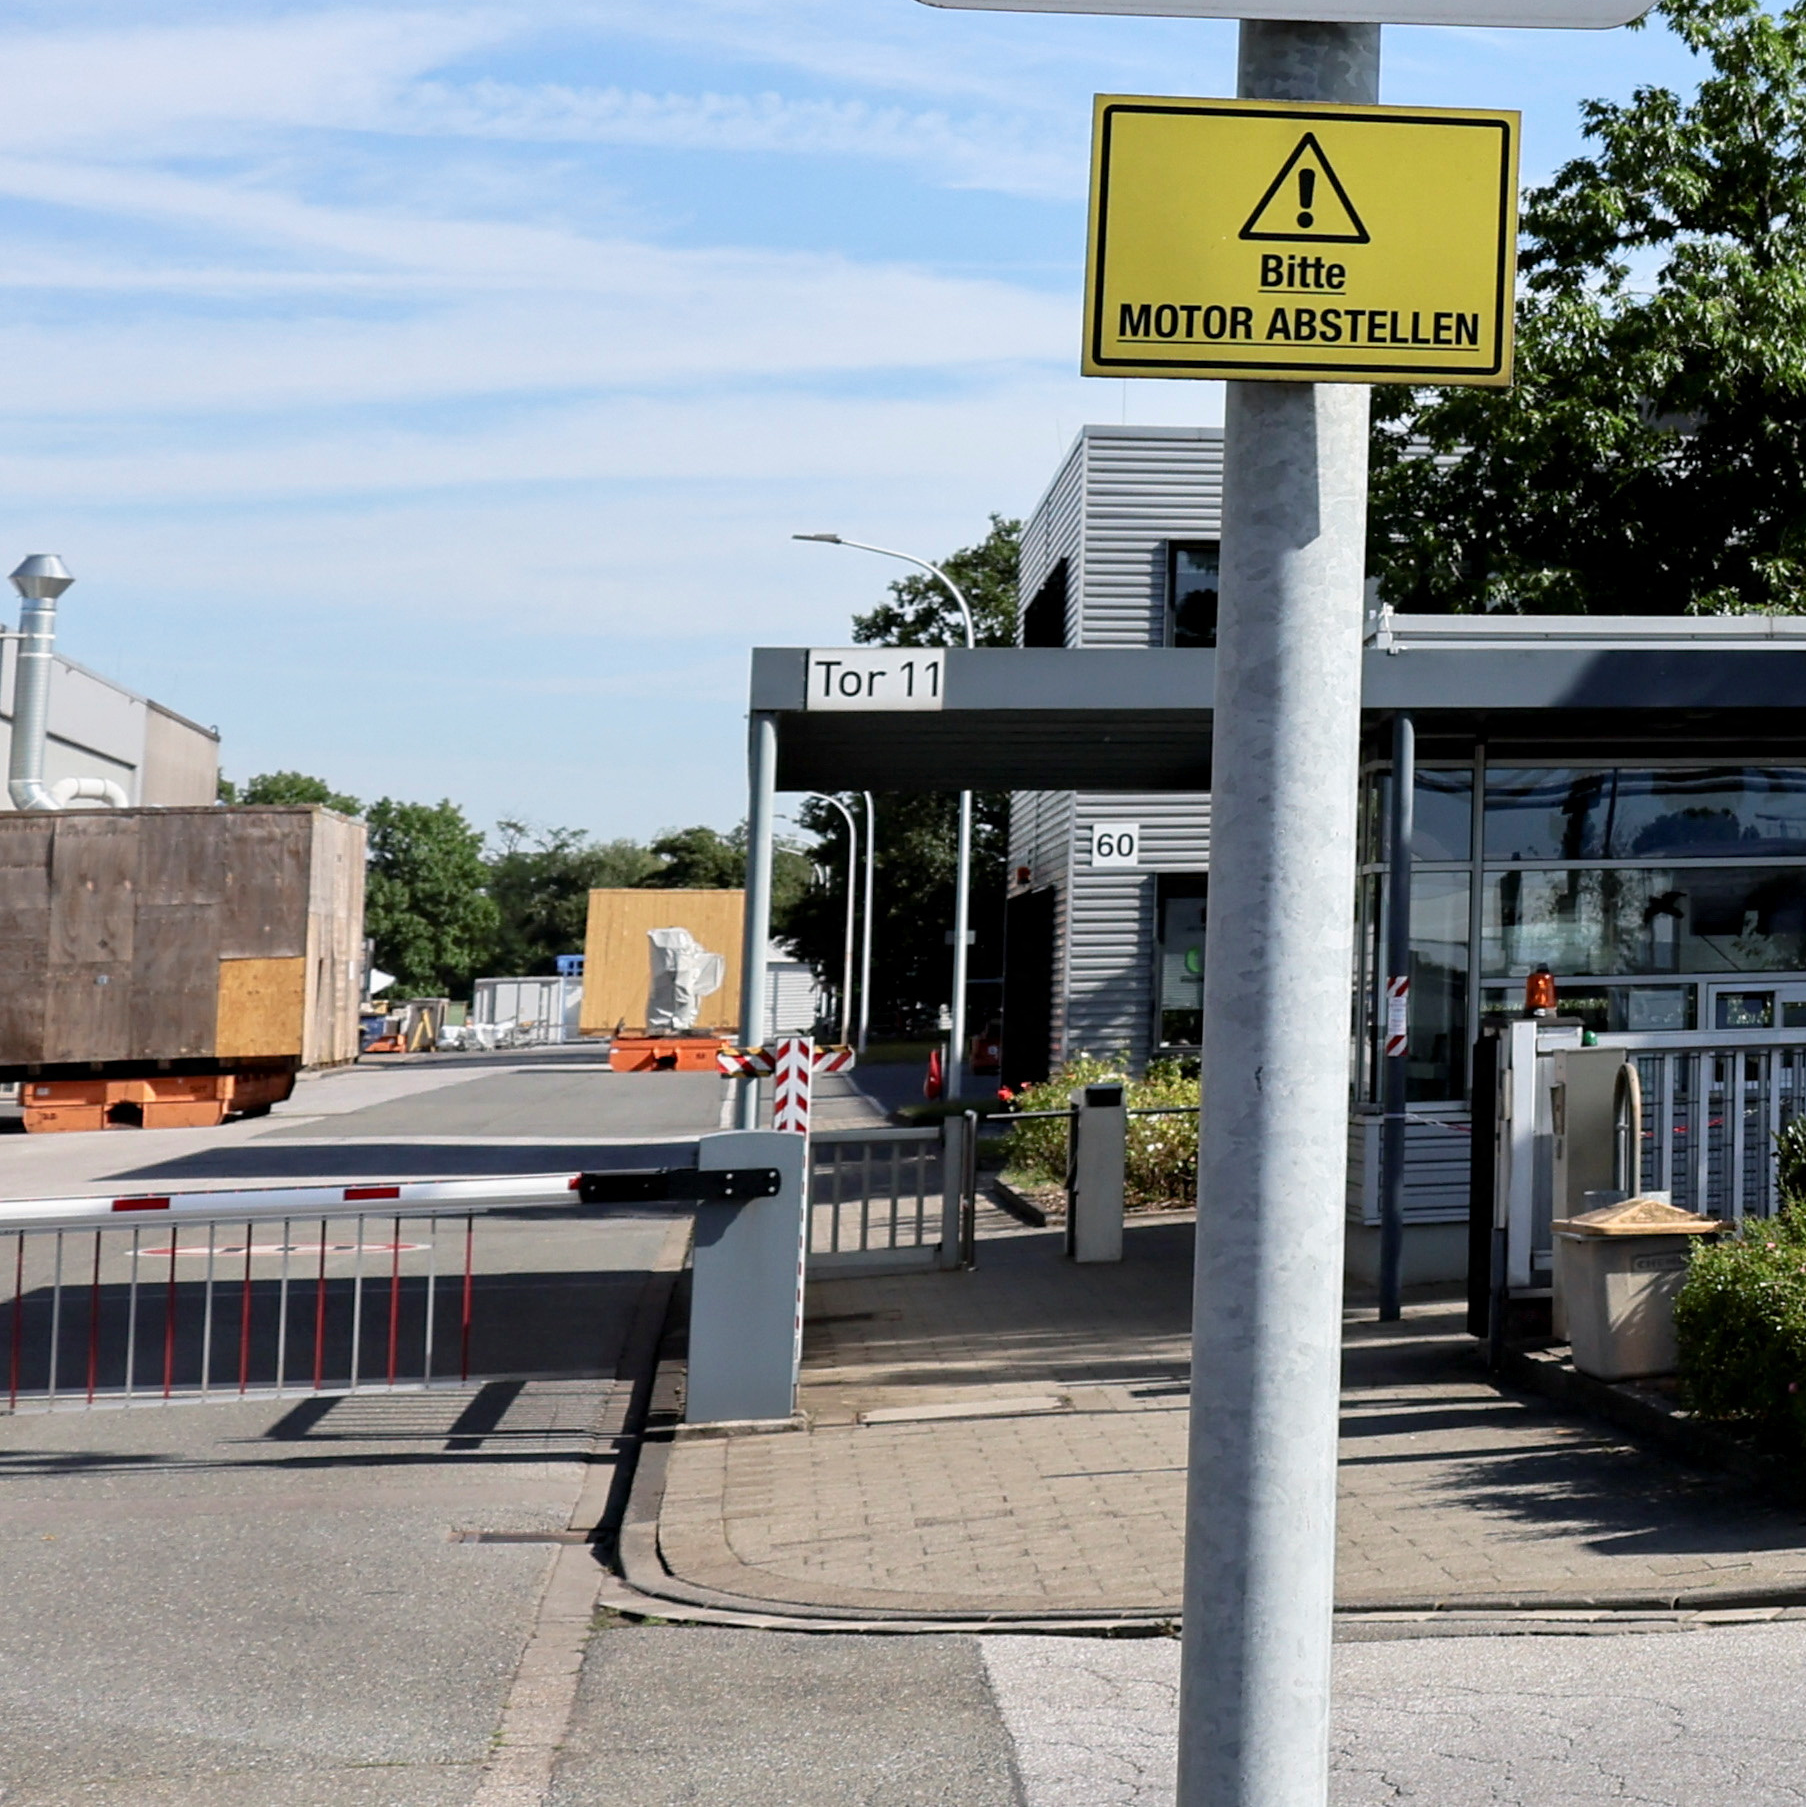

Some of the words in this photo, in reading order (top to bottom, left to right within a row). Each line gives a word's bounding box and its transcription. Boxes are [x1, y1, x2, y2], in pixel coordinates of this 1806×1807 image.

[1261, 254, 1346, 290] Bitte
[1119, 303, 1253, 340] MOTOR
[1266, 307, 1480, 346] ABSTELLEN
[815, 661, 886, 696] Tor
[900, 661, 938, 696] 11
[1096, 833, 1134, 858] 60
